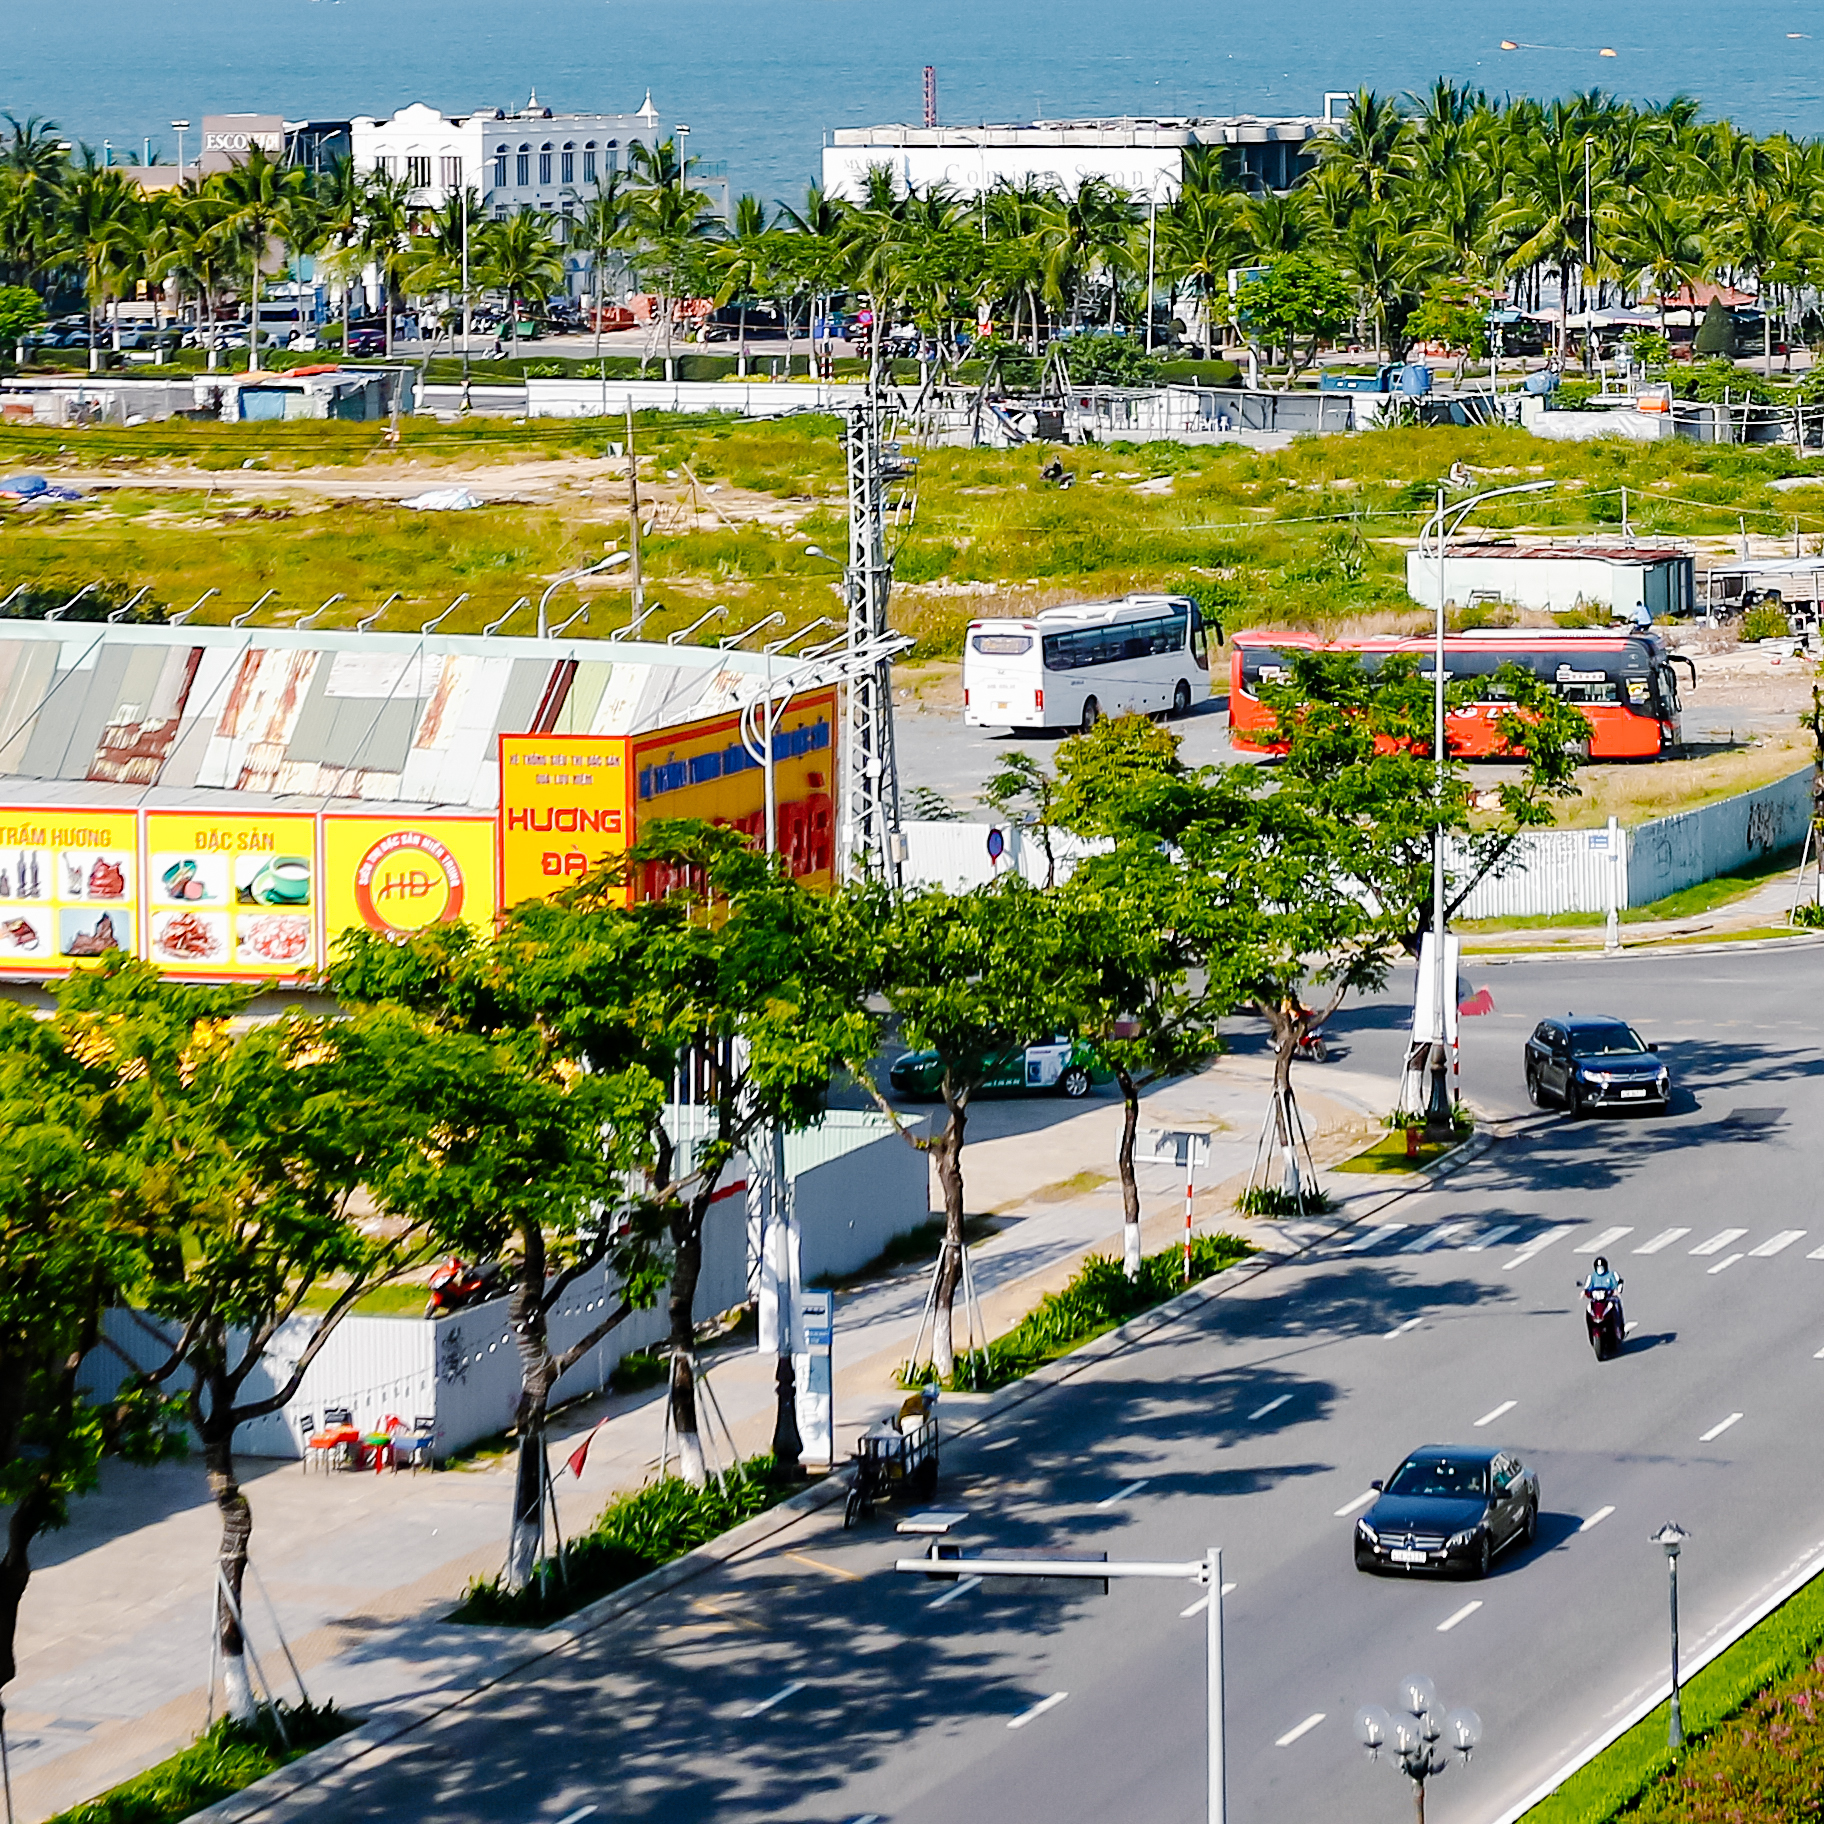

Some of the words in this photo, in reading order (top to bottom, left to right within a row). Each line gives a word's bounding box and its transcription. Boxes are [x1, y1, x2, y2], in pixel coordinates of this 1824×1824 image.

[206, 134, 247, 150] ESCO
[508, 806, 622, 834] HƯƠNG
[194, 829, 233, 854] ĐẶC
[236, 826, 276, 852] SẢN
[541, 843, 588, 877] ĐÀ
